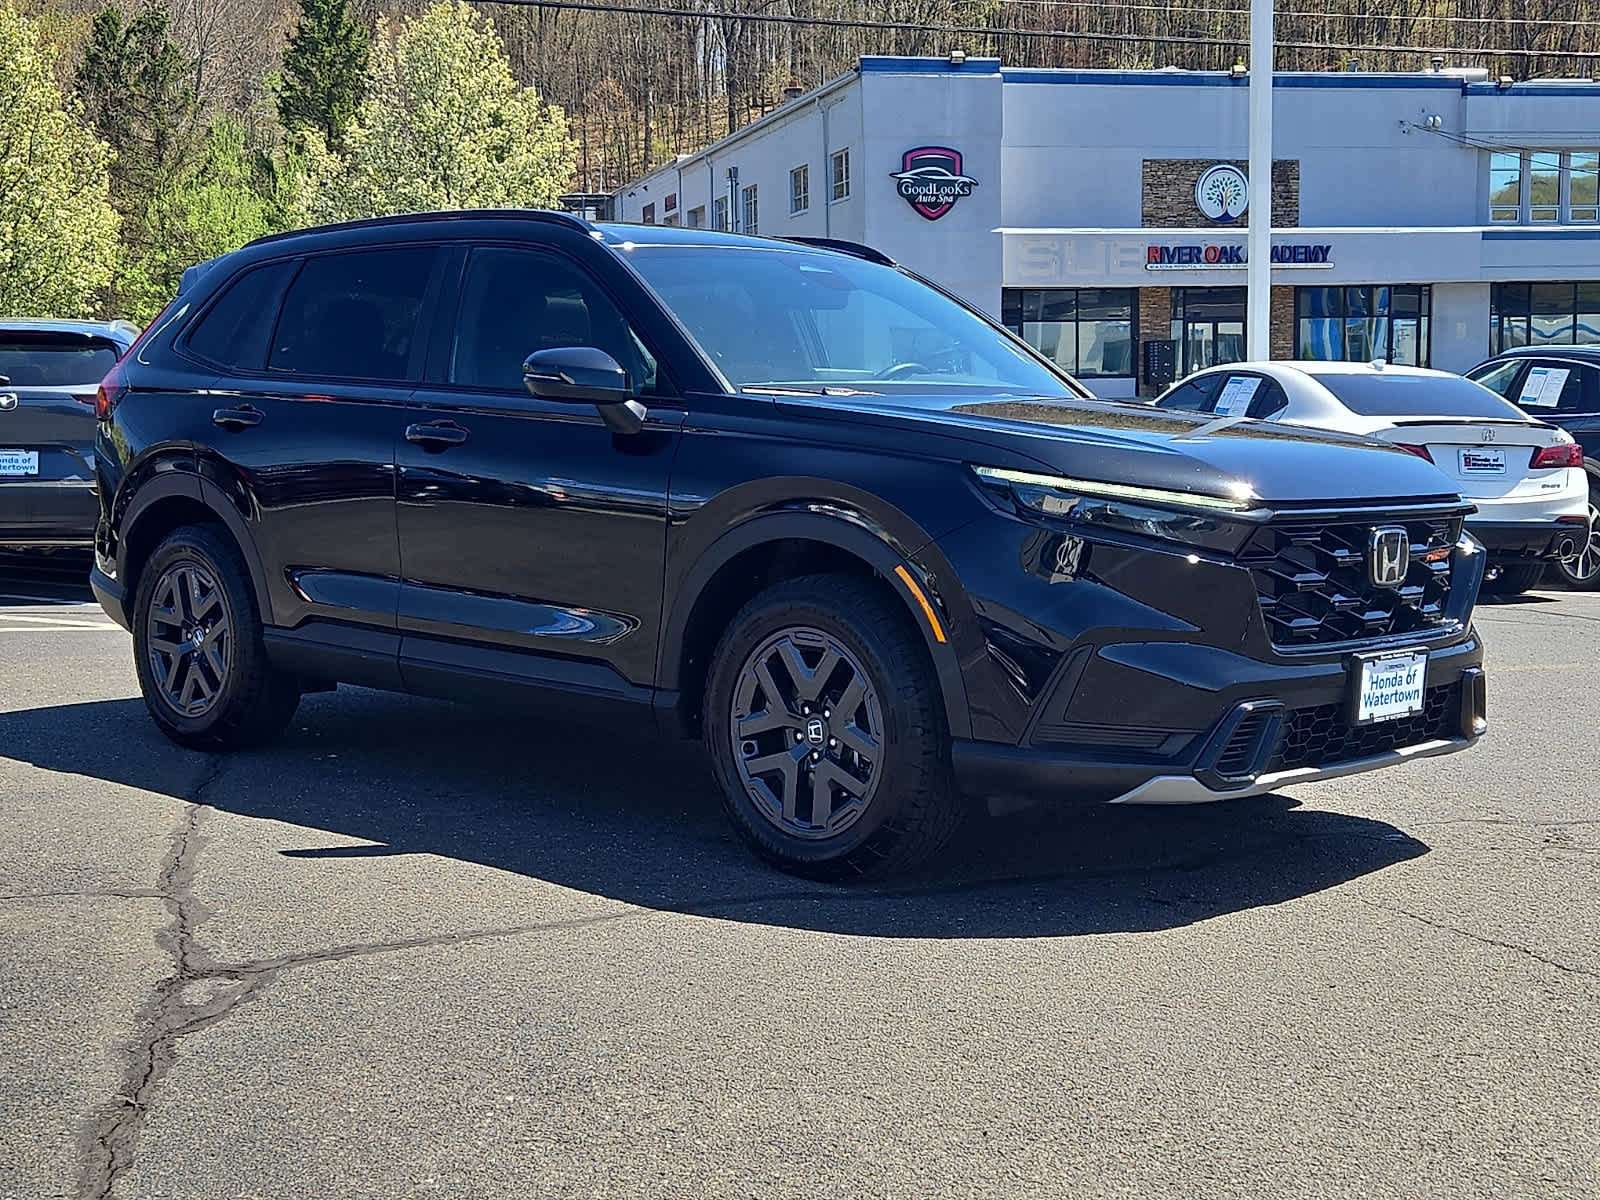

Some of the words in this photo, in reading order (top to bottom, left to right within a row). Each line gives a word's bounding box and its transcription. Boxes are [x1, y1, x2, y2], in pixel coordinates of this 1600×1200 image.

[915, 194, 936, 203] Auto
[937, 194, 954, 205] Spa
[1147, 245, 1202, 264] RIVER
[1204, 245, 1243, 264] OAK
[1370, 671, 1403, 691] Honda
[1406, 668, 1418, 685] of
[1364, 688, 1420, 708] Watertown
